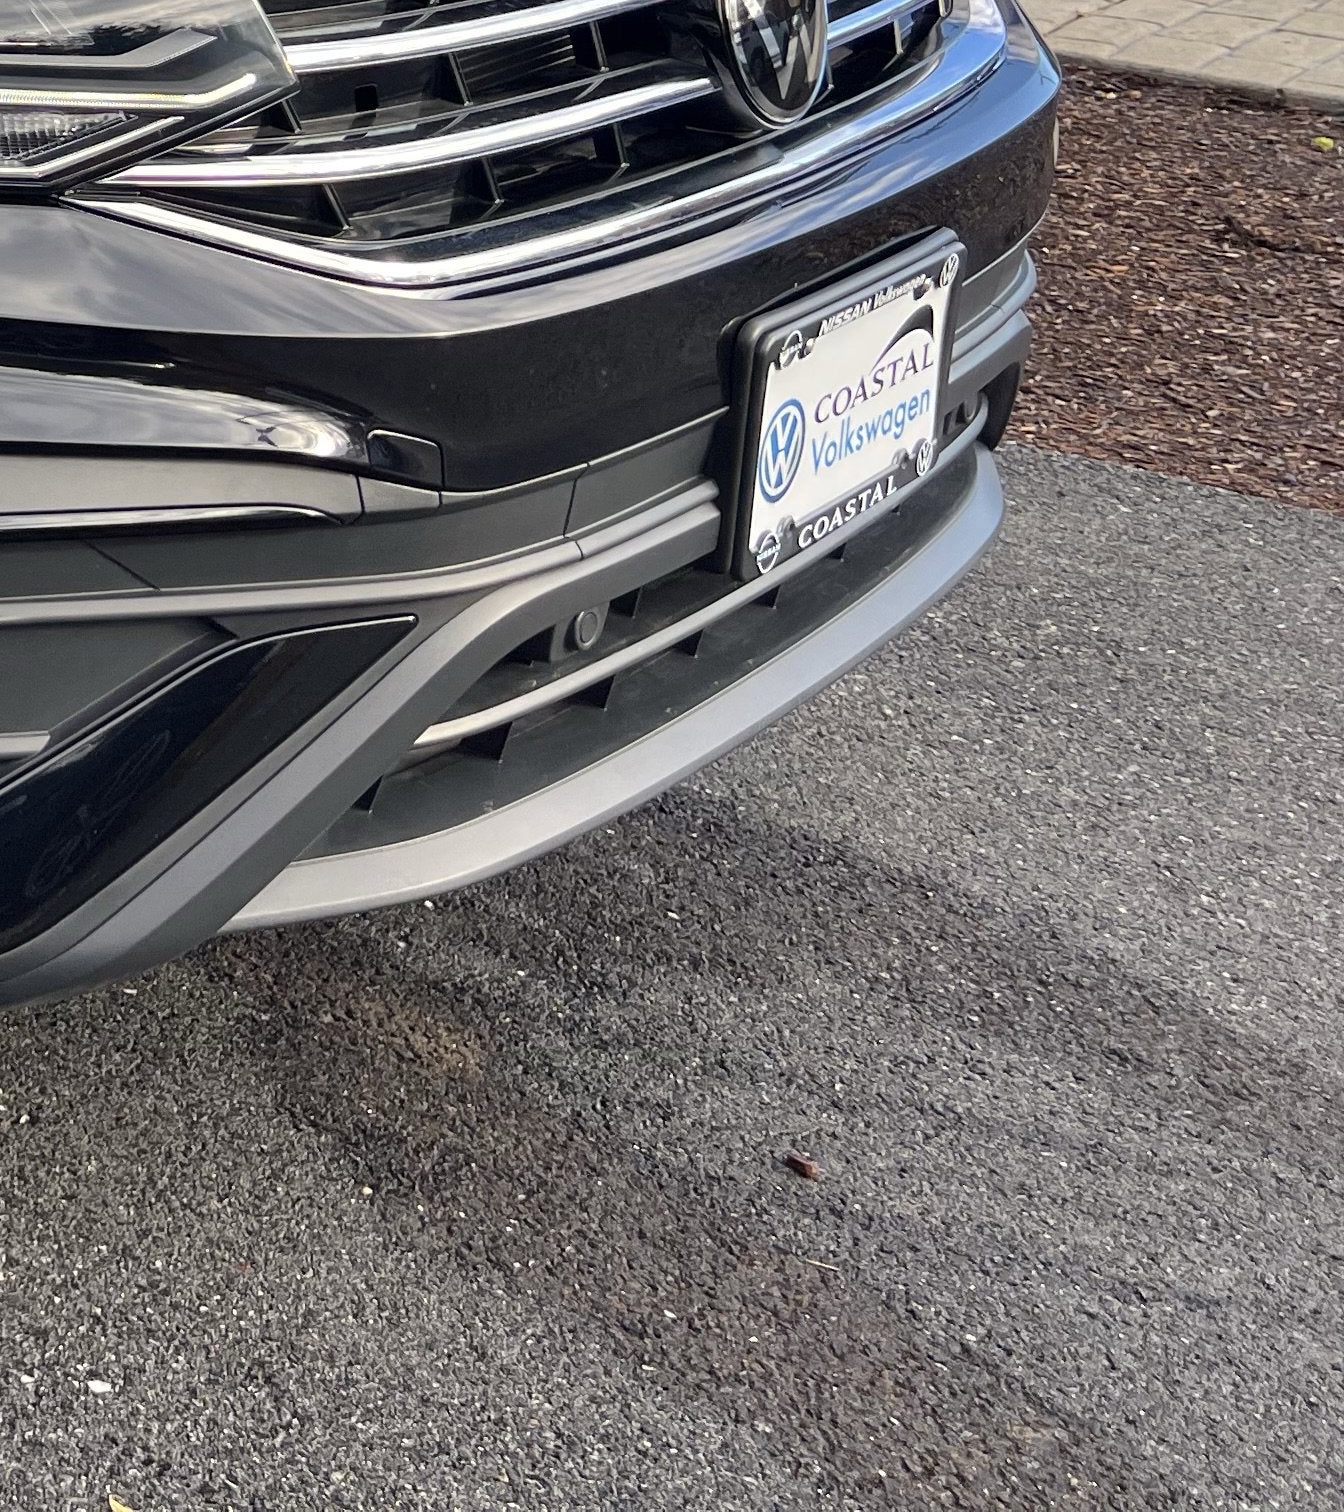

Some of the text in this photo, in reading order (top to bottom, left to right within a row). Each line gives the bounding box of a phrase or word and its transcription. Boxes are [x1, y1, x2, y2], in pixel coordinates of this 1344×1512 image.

[819, 298, 872, 337] NISSAN
[814, 342, 934, 424] COASTAL
[758, 398, 806, 503] VW
[812, 389, 930, 475] Volkswagen
[797, 475, 897, 549] COASTAL
